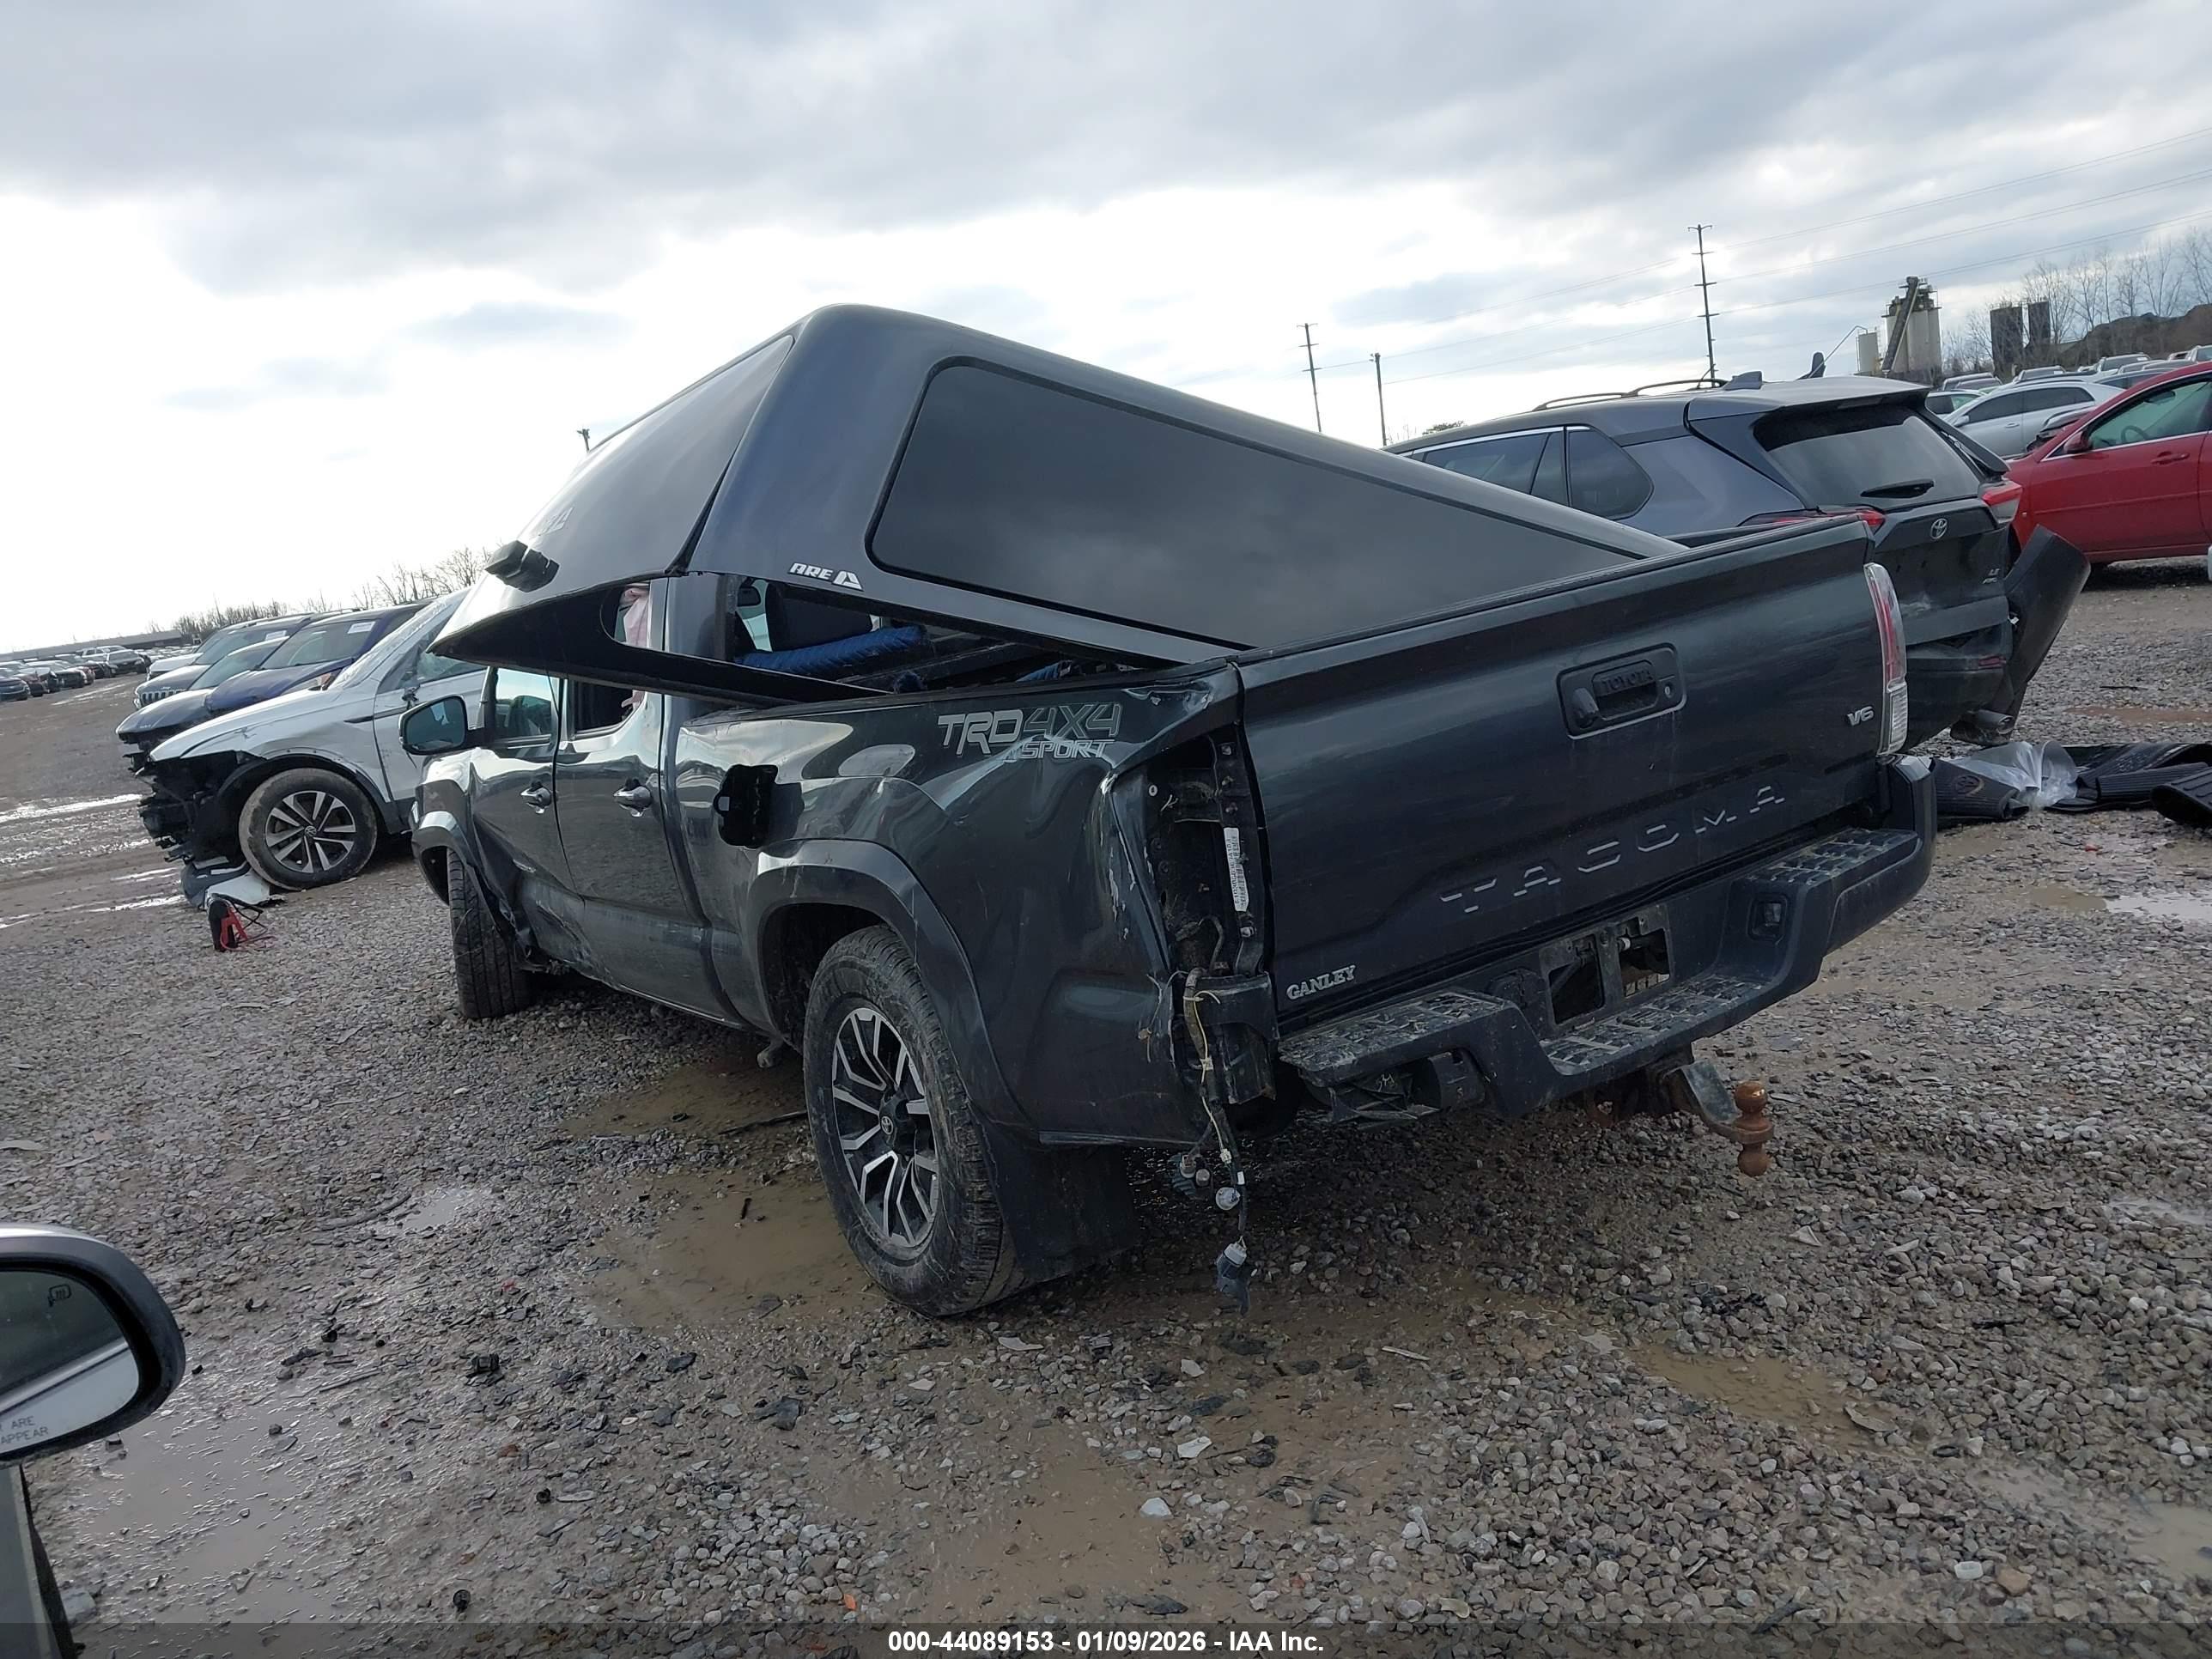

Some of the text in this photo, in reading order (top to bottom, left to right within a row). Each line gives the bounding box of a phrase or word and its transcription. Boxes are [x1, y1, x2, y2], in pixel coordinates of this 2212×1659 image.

[789, 562, 834, 580] ARE
[1846, 706, 1875, 726] V6
[937, 709, 1024, 756] TRD
[1021, 739, 1115, 759] SPORT
[1439, 785, 1785, 915] TACOMA
[1286, 964, 1356, 1000] GANLEY
[11, 1415, 35, 1430] ARE
[1, 1426, 48, 1443] APPEAR
